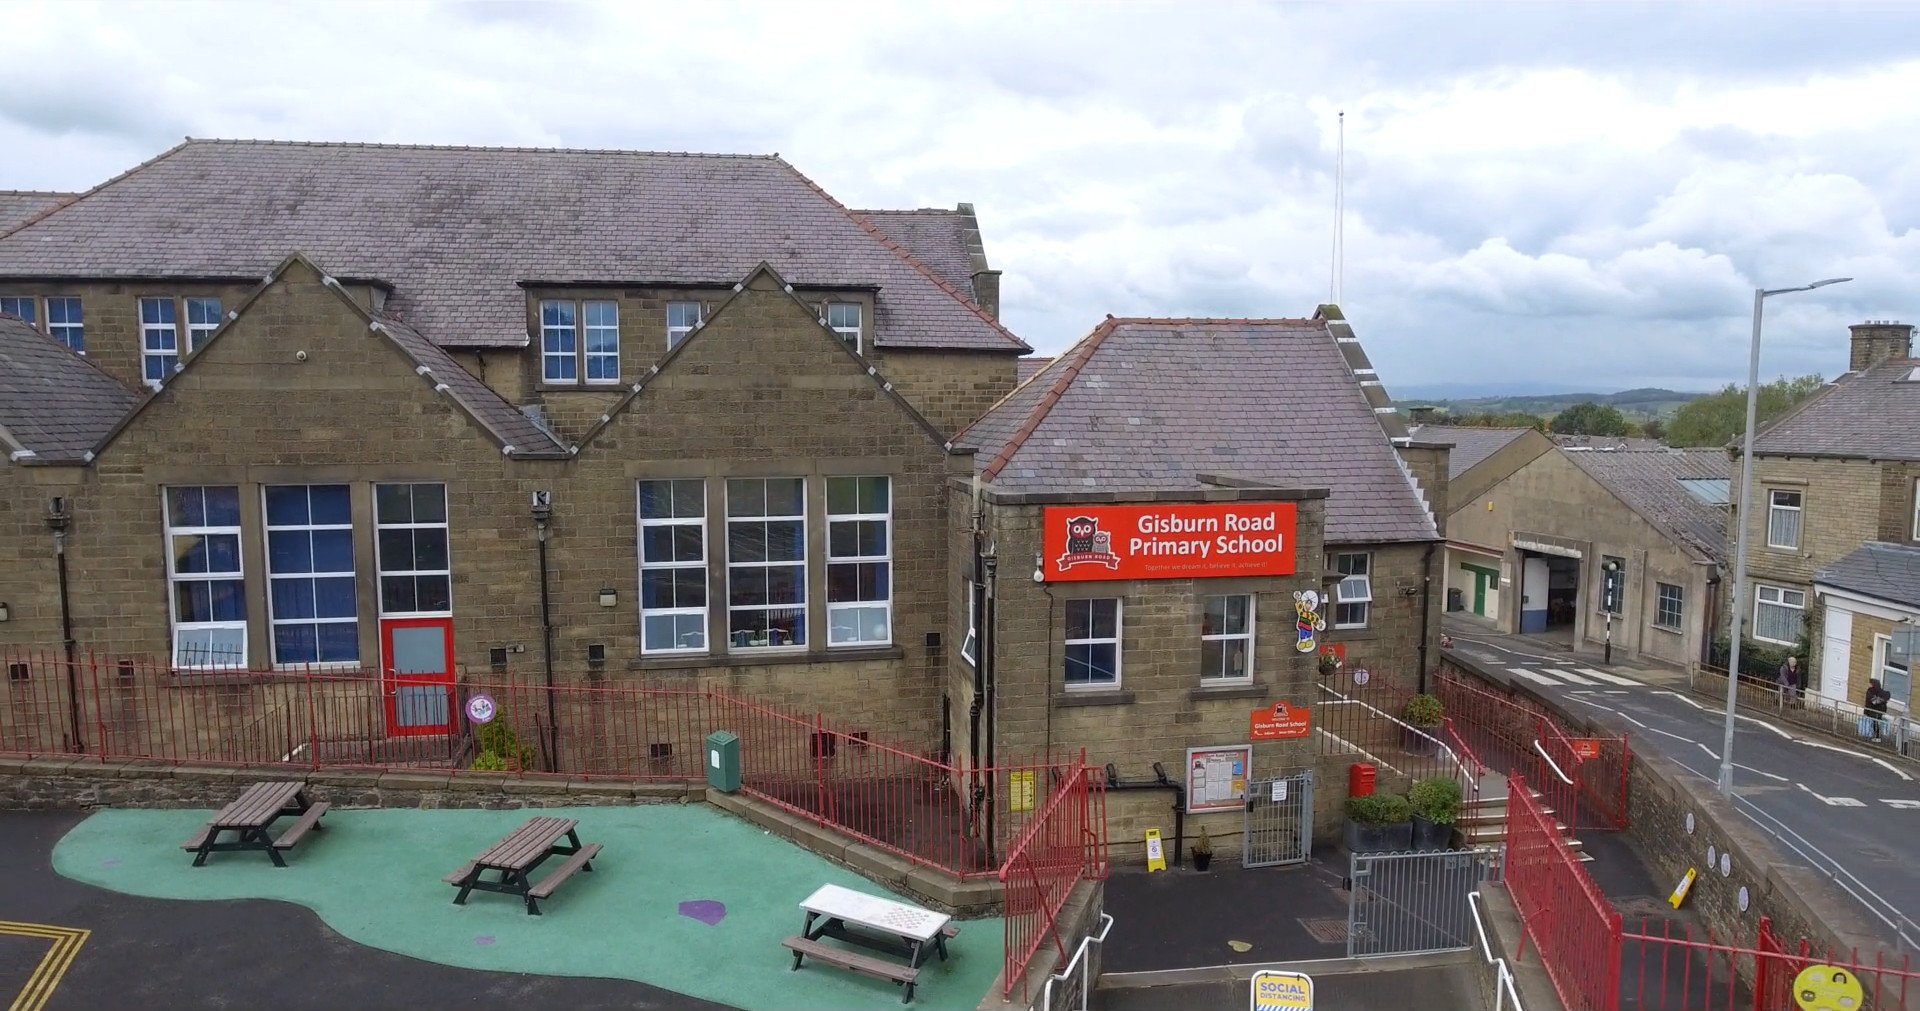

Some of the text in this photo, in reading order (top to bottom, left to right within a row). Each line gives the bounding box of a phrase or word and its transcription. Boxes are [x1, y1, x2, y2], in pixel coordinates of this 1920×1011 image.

[1138, 511, 1275, 534] Gisburn Road
[1129, 533, 1283, 559] Primary School
[1260, 982, 1305, 995] SOCIAL
[1260, 992, 1306, 1002] DISTANCING
